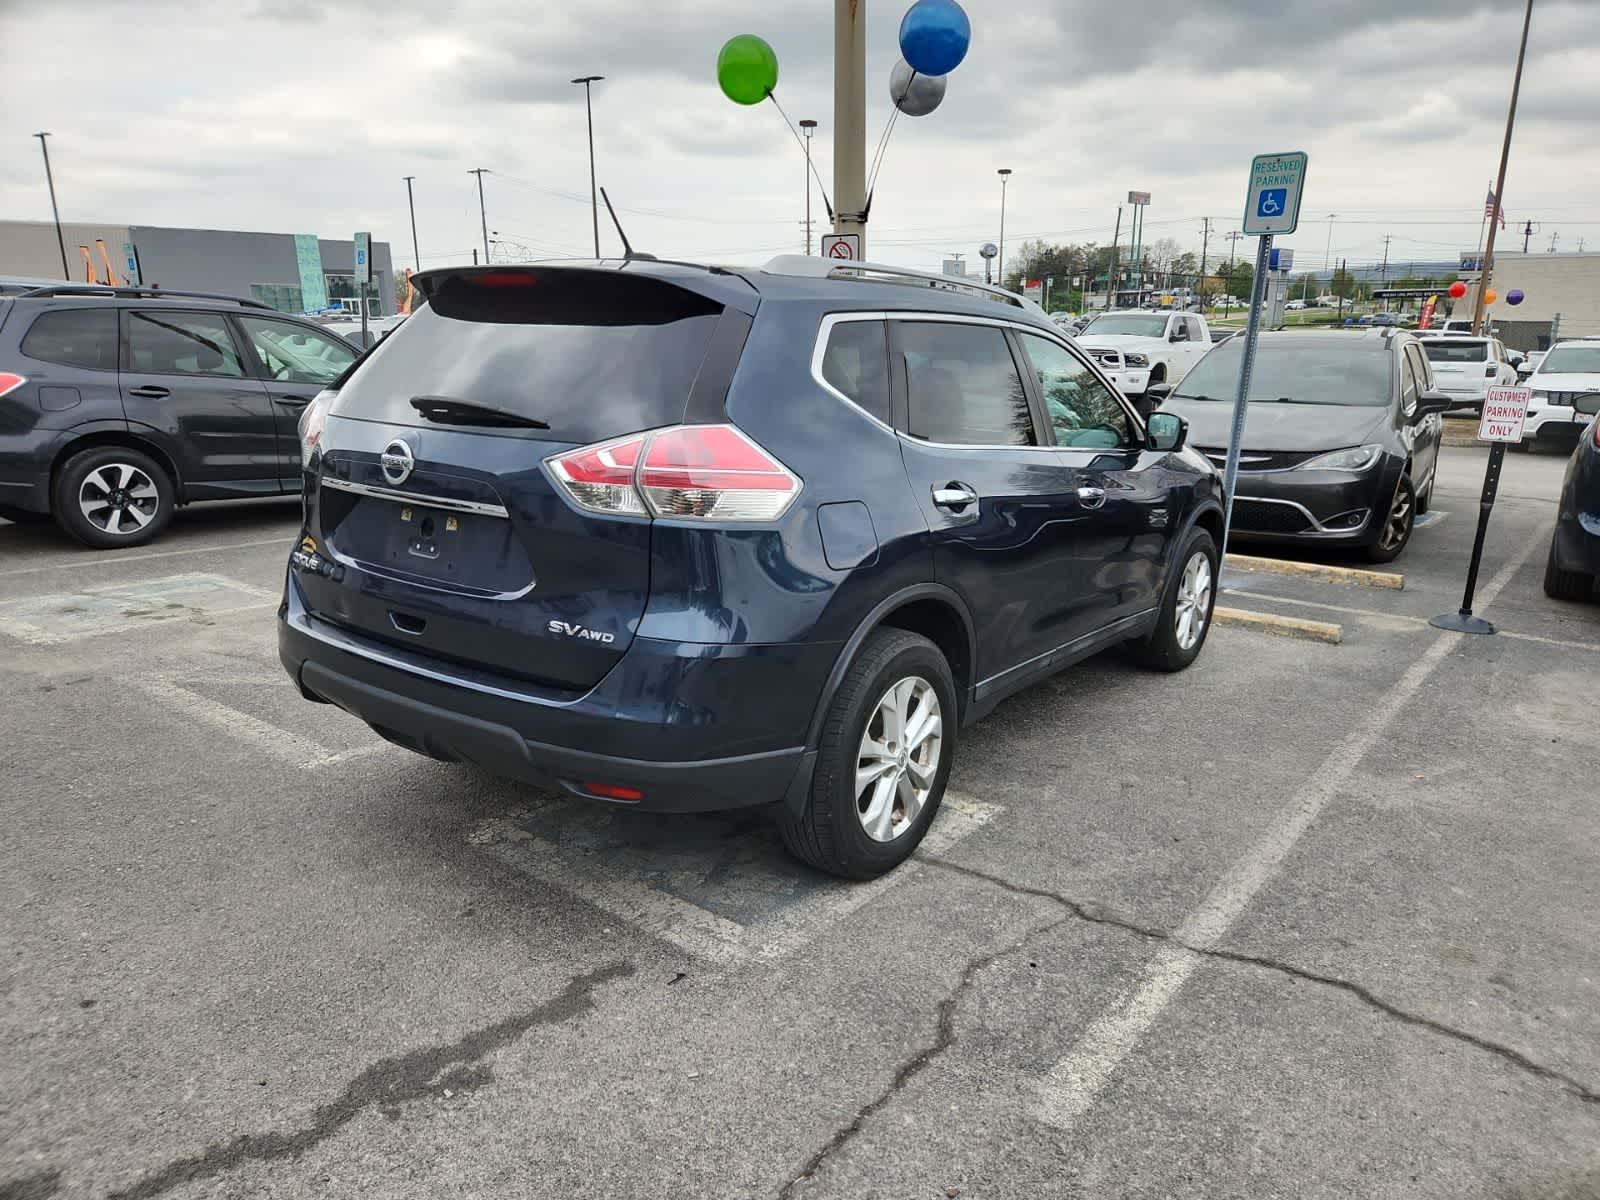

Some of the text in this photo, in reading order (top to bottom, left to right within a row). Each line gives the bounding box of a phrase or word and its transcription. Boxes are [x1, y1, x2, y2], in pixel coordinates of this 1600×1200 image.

[1255, 161, 1300, 173] RESERVED
[1256, 175, 1295, 187] PARKING
[1490, 391, 1527, 403] CUSTOMER
[1487, 407, 1523, 418] PARKING
[1489, 425, 1514, 436] ONLY
[548, 619, 615, 643] SV AWD
